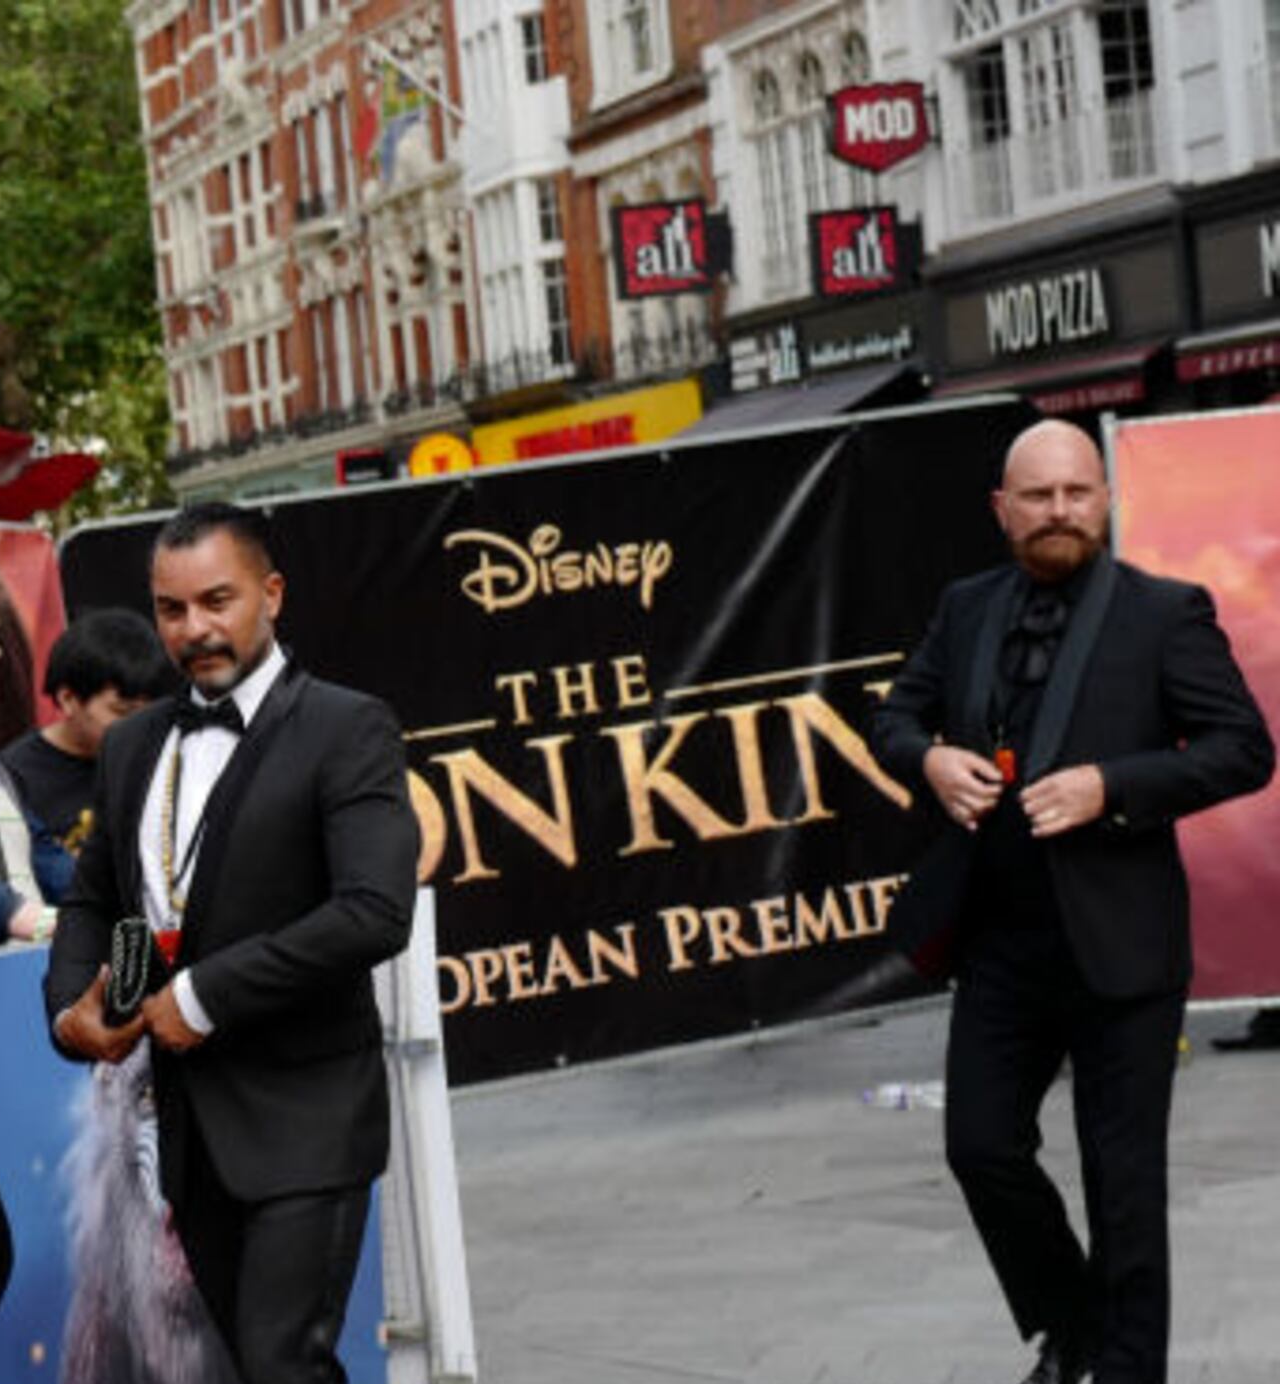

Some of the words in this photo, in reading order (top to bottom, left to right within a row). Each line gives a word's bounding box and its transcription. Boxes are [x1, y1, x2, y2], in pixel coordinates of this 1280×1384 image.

[844, 99, 916, 144] MOD
[986, 283, 1039, 354] MOD
[1039, 269, 1109, 344] PIZZA
[495, 654, 652, 725] THE
